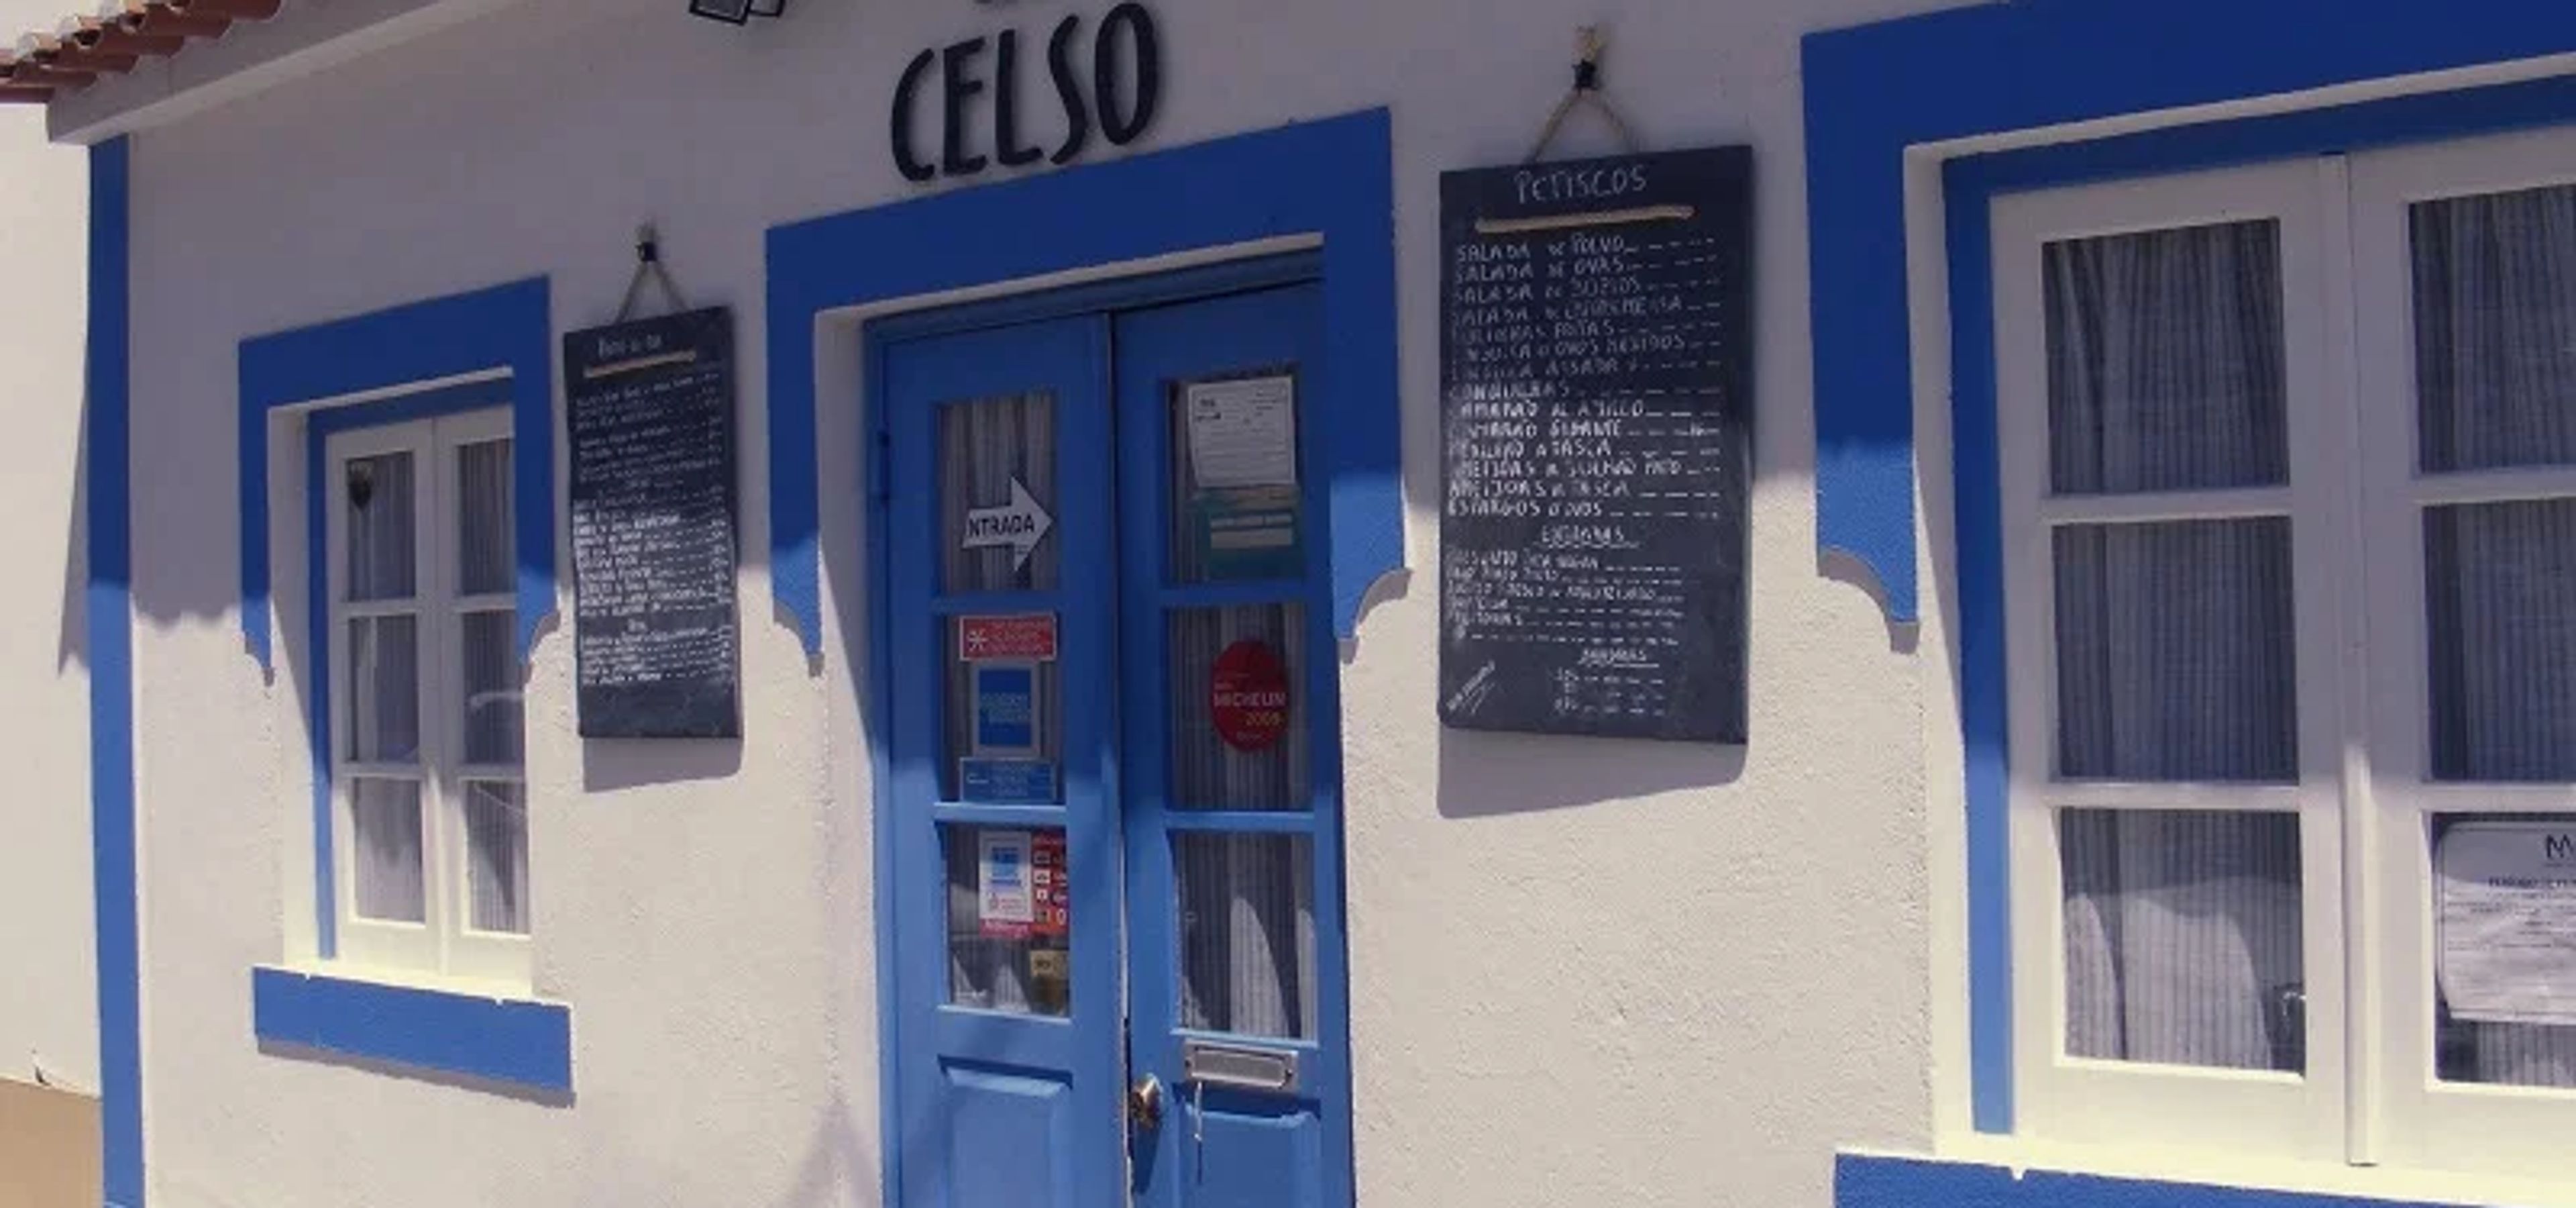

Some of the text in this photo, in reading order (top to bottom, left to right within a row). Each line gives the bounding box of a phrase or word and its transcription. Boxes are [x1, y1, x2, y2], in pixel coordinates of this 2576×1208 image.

[890, 3, 1157, 181] CELSO
[1515, 166, 1647, 203] PETISCOS
[1456, 242, 1530, 262] SALADA
[1455, 263, 1534, 284] SALADA
[1574, 258, 1623, 274] OVAS
[1454, 284, 1534, 304] SALADA
[1448, 419, 1538, 438] AMARÃO
